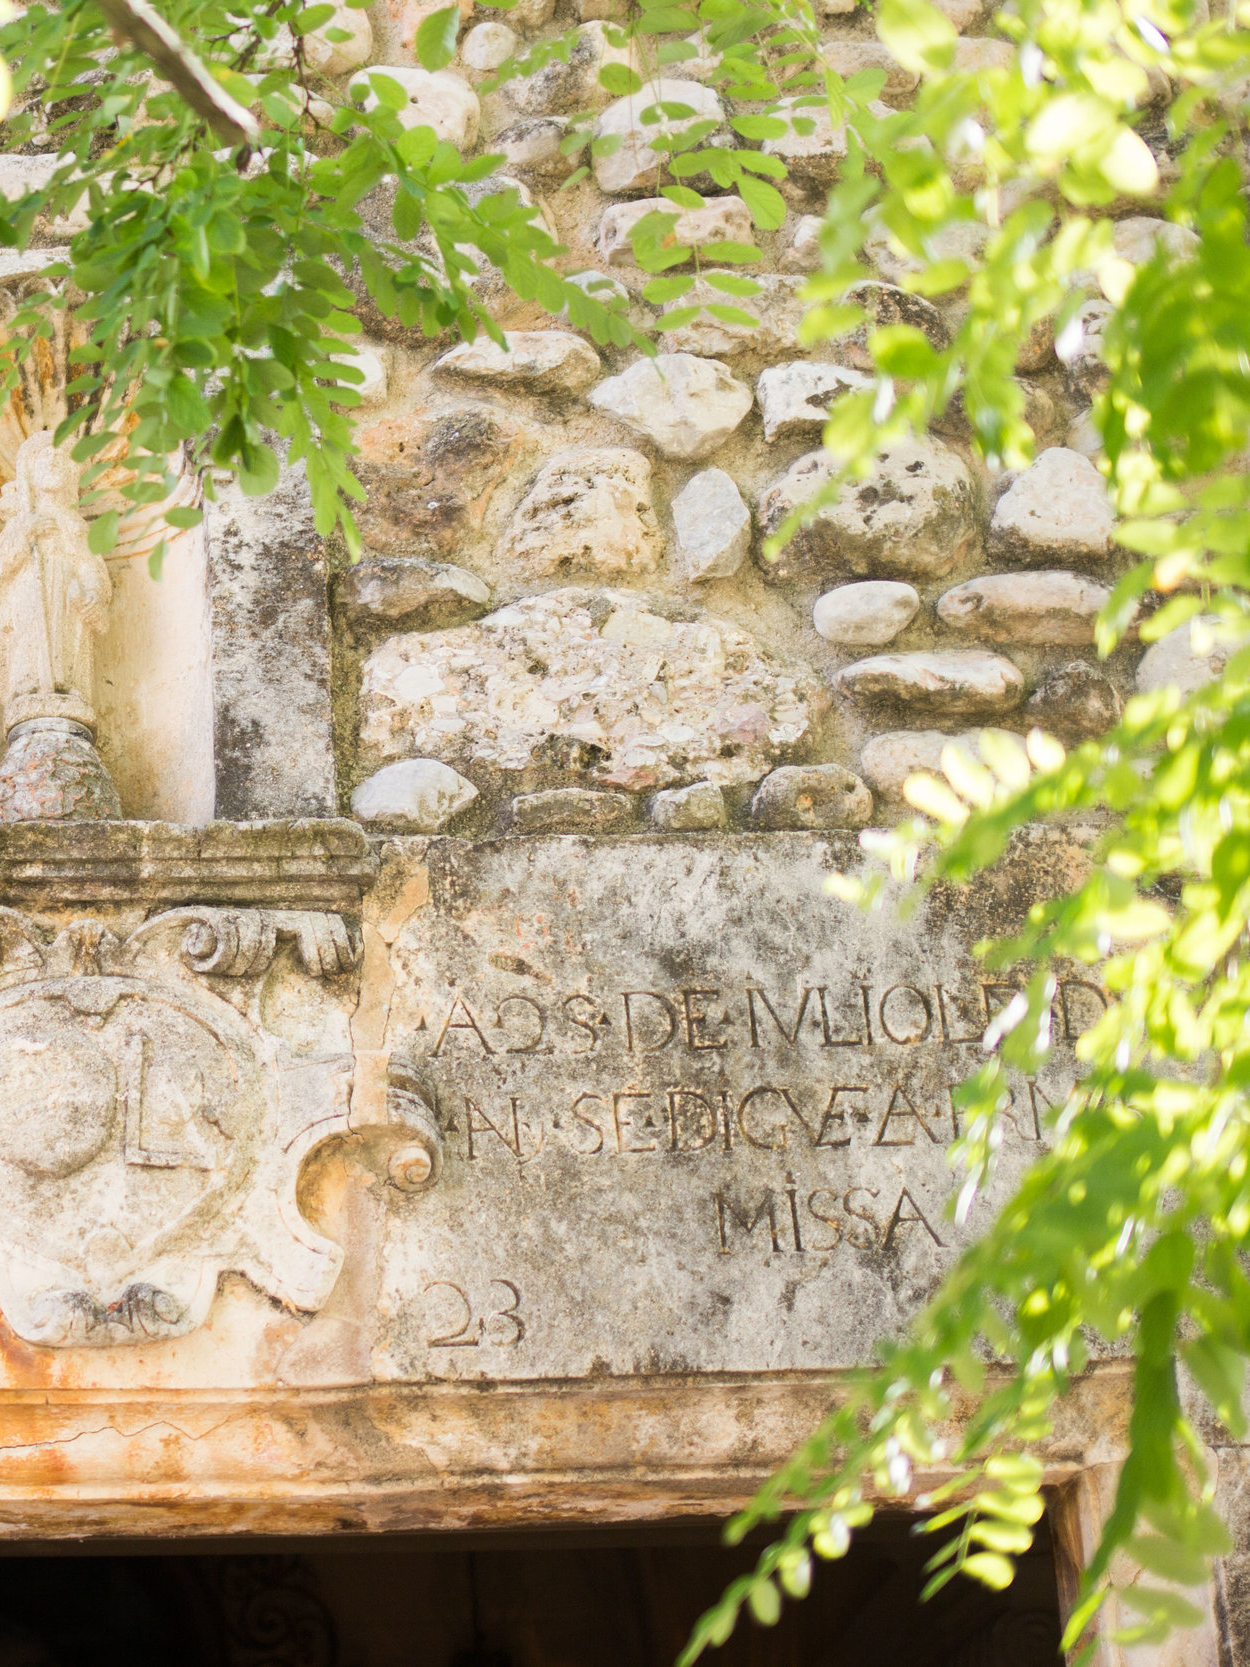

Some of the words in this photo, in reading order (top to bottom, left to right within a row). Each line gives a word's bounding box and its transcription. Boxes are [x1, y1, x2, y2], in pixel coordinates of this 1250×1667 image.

[427, 994, 498, 1058] A
[619, 988, 729, 1052] DE
[570, 1090, 658, 1156] SE
[709, 1180, 952, 1255] MISSA
[422, 1277, 527, 1349] 23
